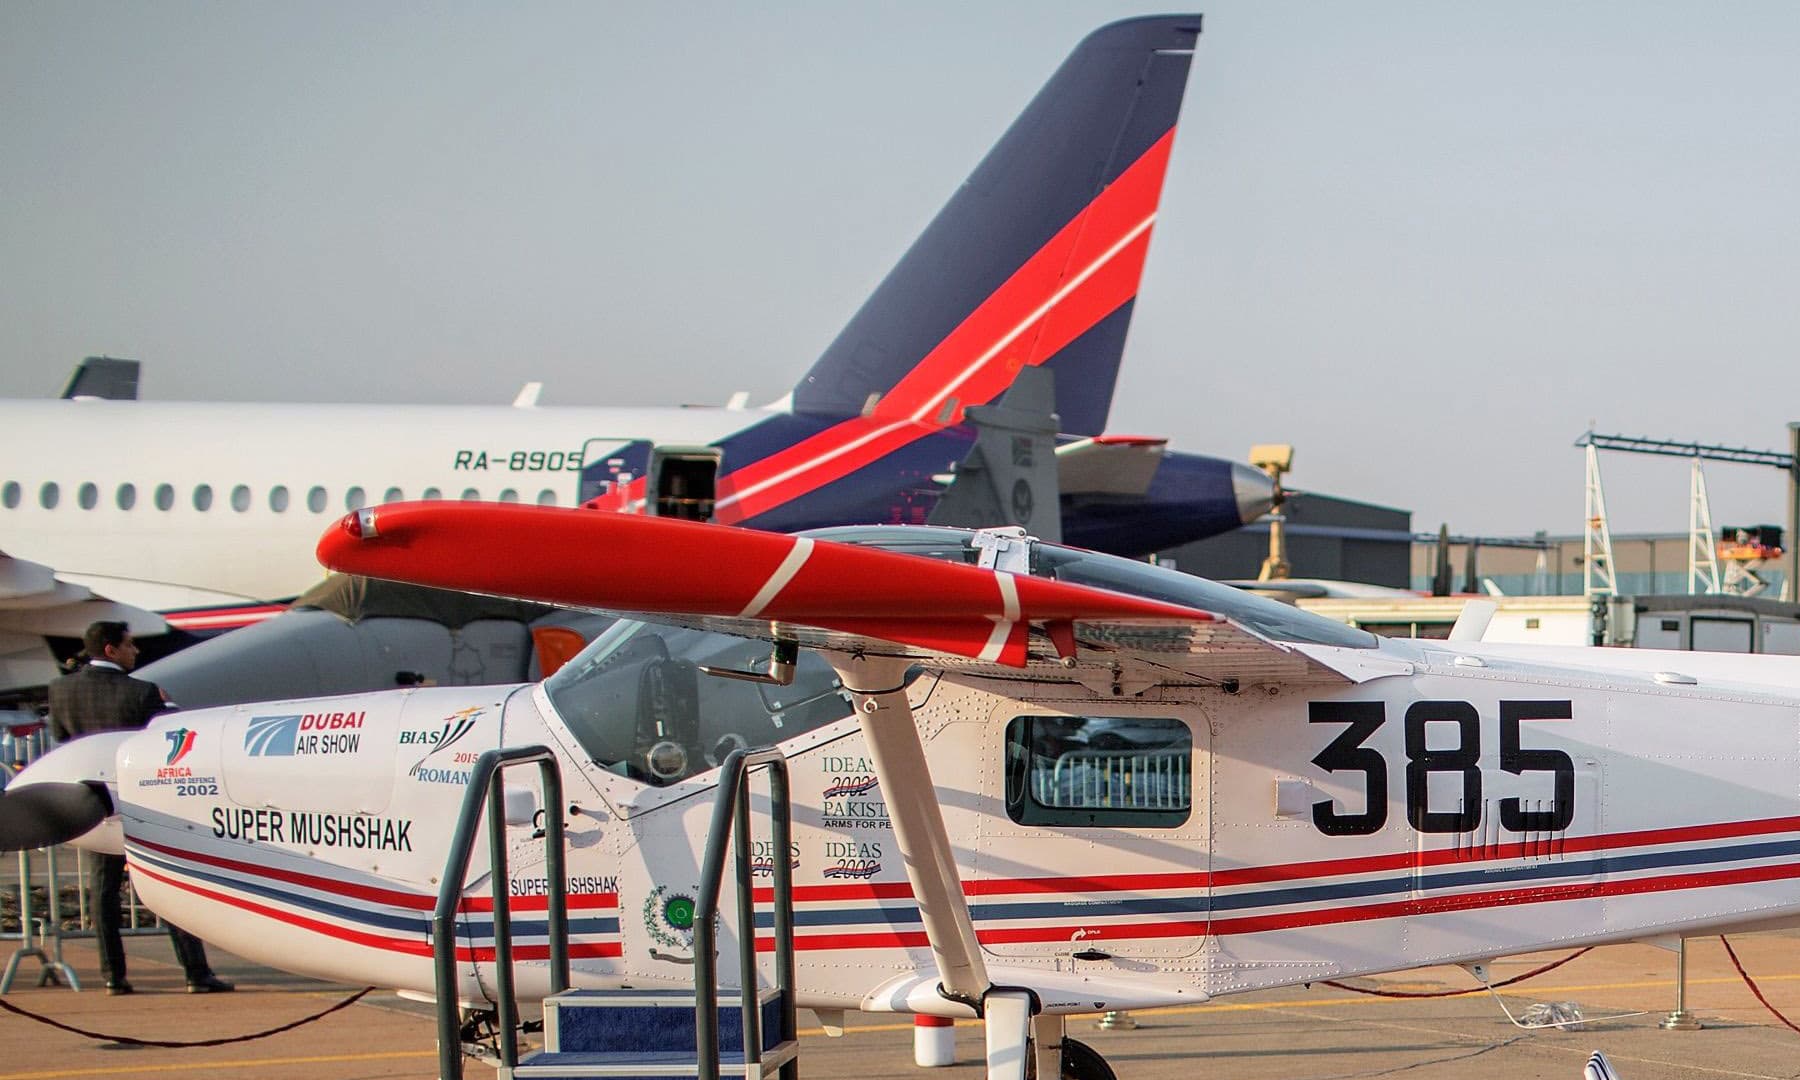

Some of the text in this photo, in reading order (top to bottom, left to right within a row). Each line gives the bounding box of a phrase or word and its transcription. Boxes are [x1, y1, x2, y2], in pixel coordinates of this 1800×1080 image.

[300, 711, 366, 731] DUBAI
[296, 734, 360, 754] AIR SHOW
[399, 731, 440, 744] BIAS
[453, 752, 479, 764] 2015
[1307, 700, 1575, 836] 385
[176, 785, 219, 796] 2002
[832, 776, 868, 796] 2002
[823, 801, 889, 818] PAKIST
[212, 807, 412, 852] SUPER MUSHSHAK
[824, 820, 853, 829] ARMS
[856, 821, 876, 829] FOR
[825, 842, 882, 859] IDEAS
